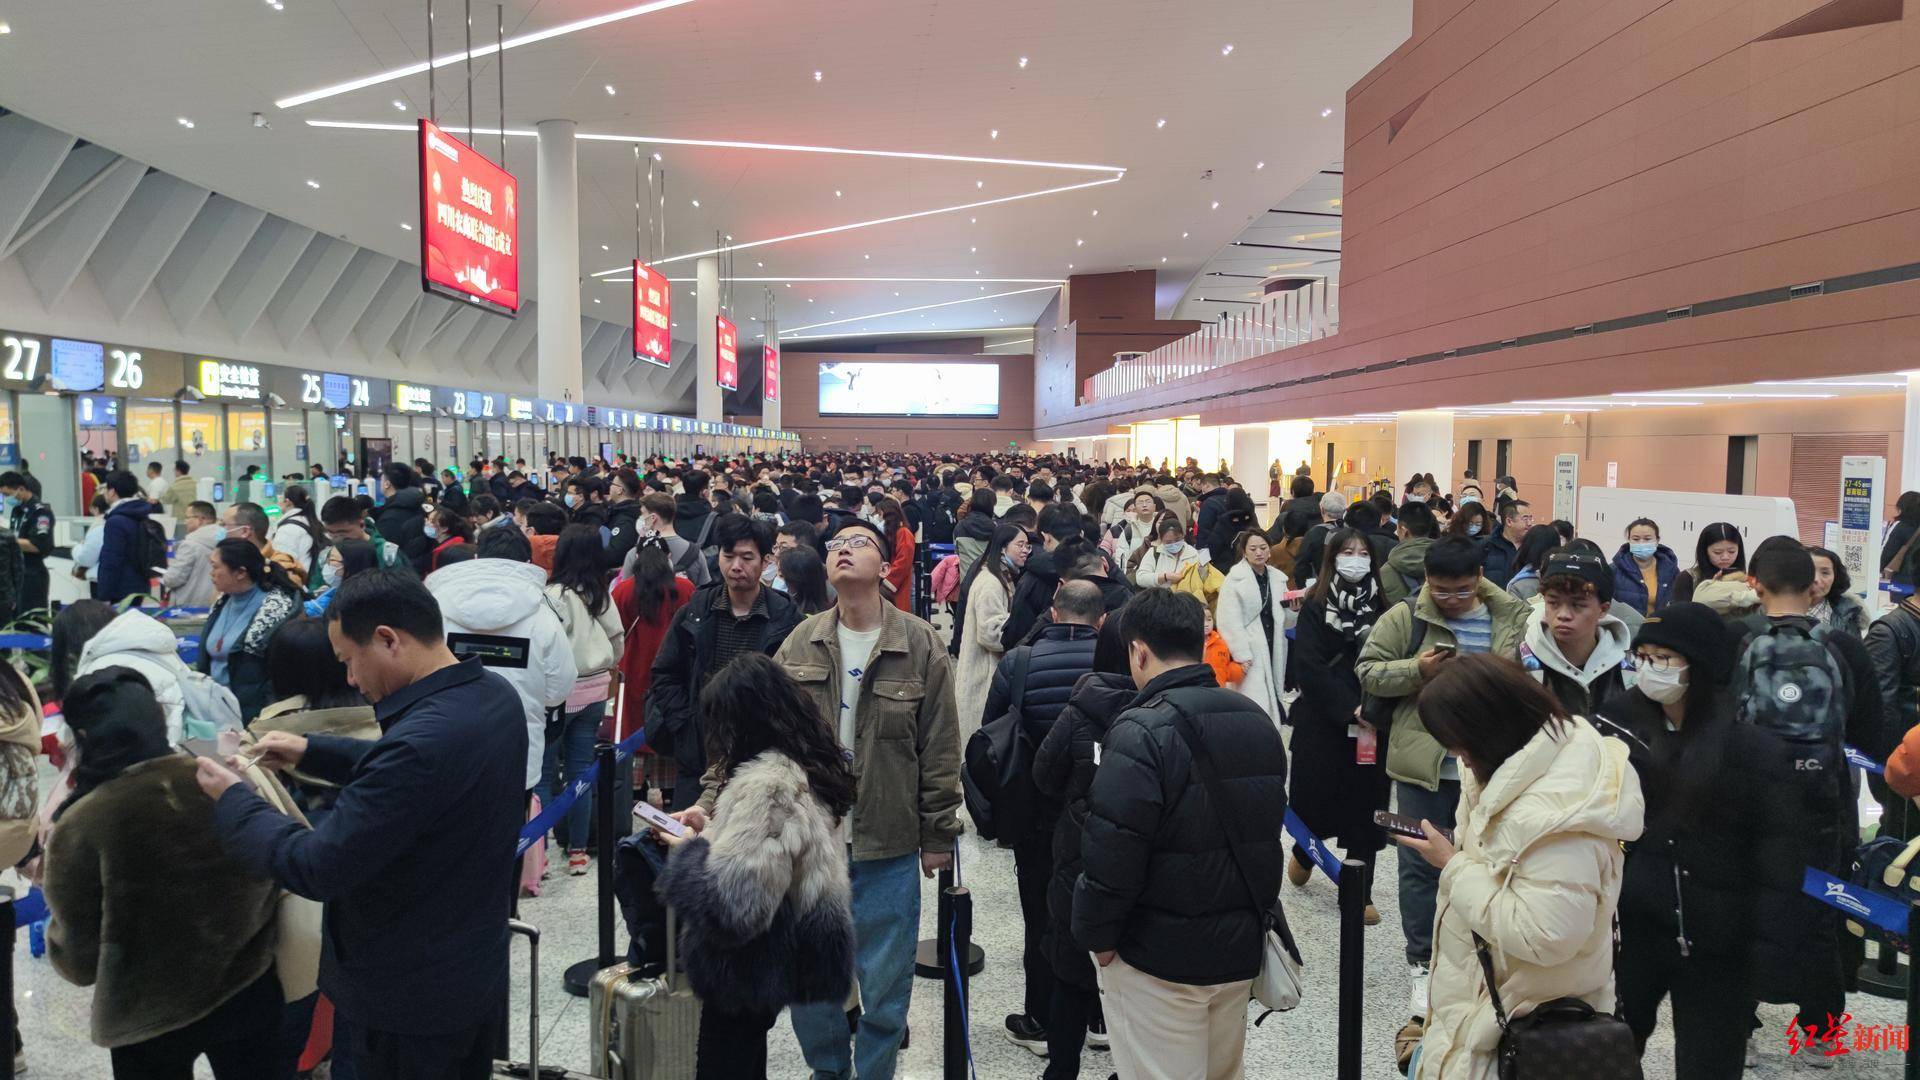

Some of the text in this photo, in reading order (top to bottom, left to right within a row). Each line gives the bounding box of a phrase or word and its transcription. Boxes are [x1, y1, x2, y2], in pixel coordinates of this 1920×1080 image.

[3, 336, 40, 381] 27
[111, 350, 143, 389] 26
[302, 374, 321, 403] 25
[352, 379, 369, 406] 24
[453, 392, 465, 415] 23
